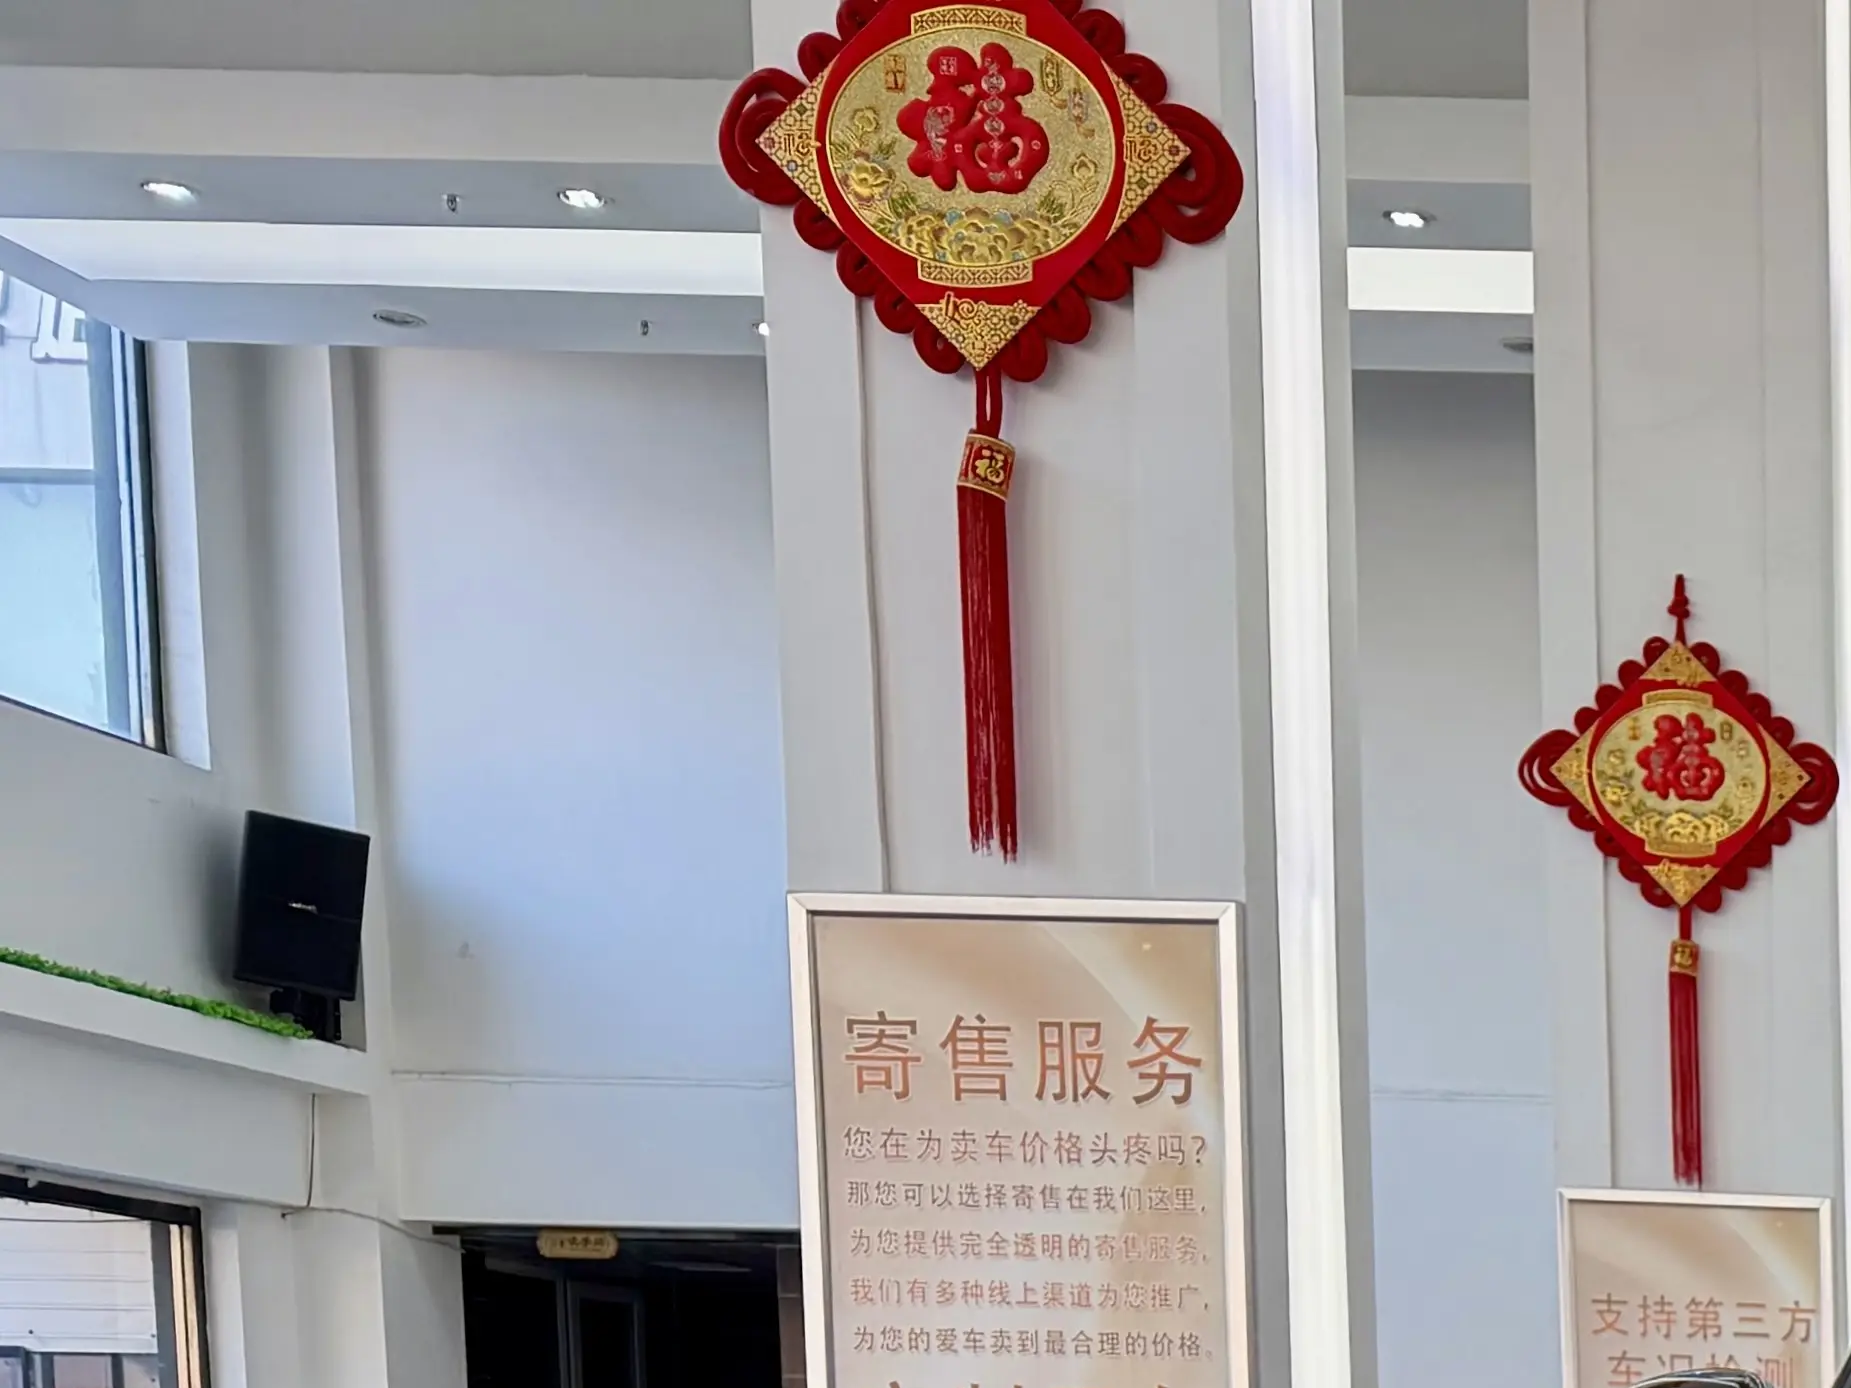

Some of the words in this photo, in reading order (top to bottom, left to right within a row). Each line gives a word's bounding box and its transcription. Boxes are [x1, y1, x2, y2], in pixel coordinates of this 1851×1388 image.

[896, 42, 1050, 195] 福
[1636, 711, 1725, 801] 福
[844, 1010, 1204, 1106] 寄售服务
[1591, 1292, 1817, 1346] 支持第三方
